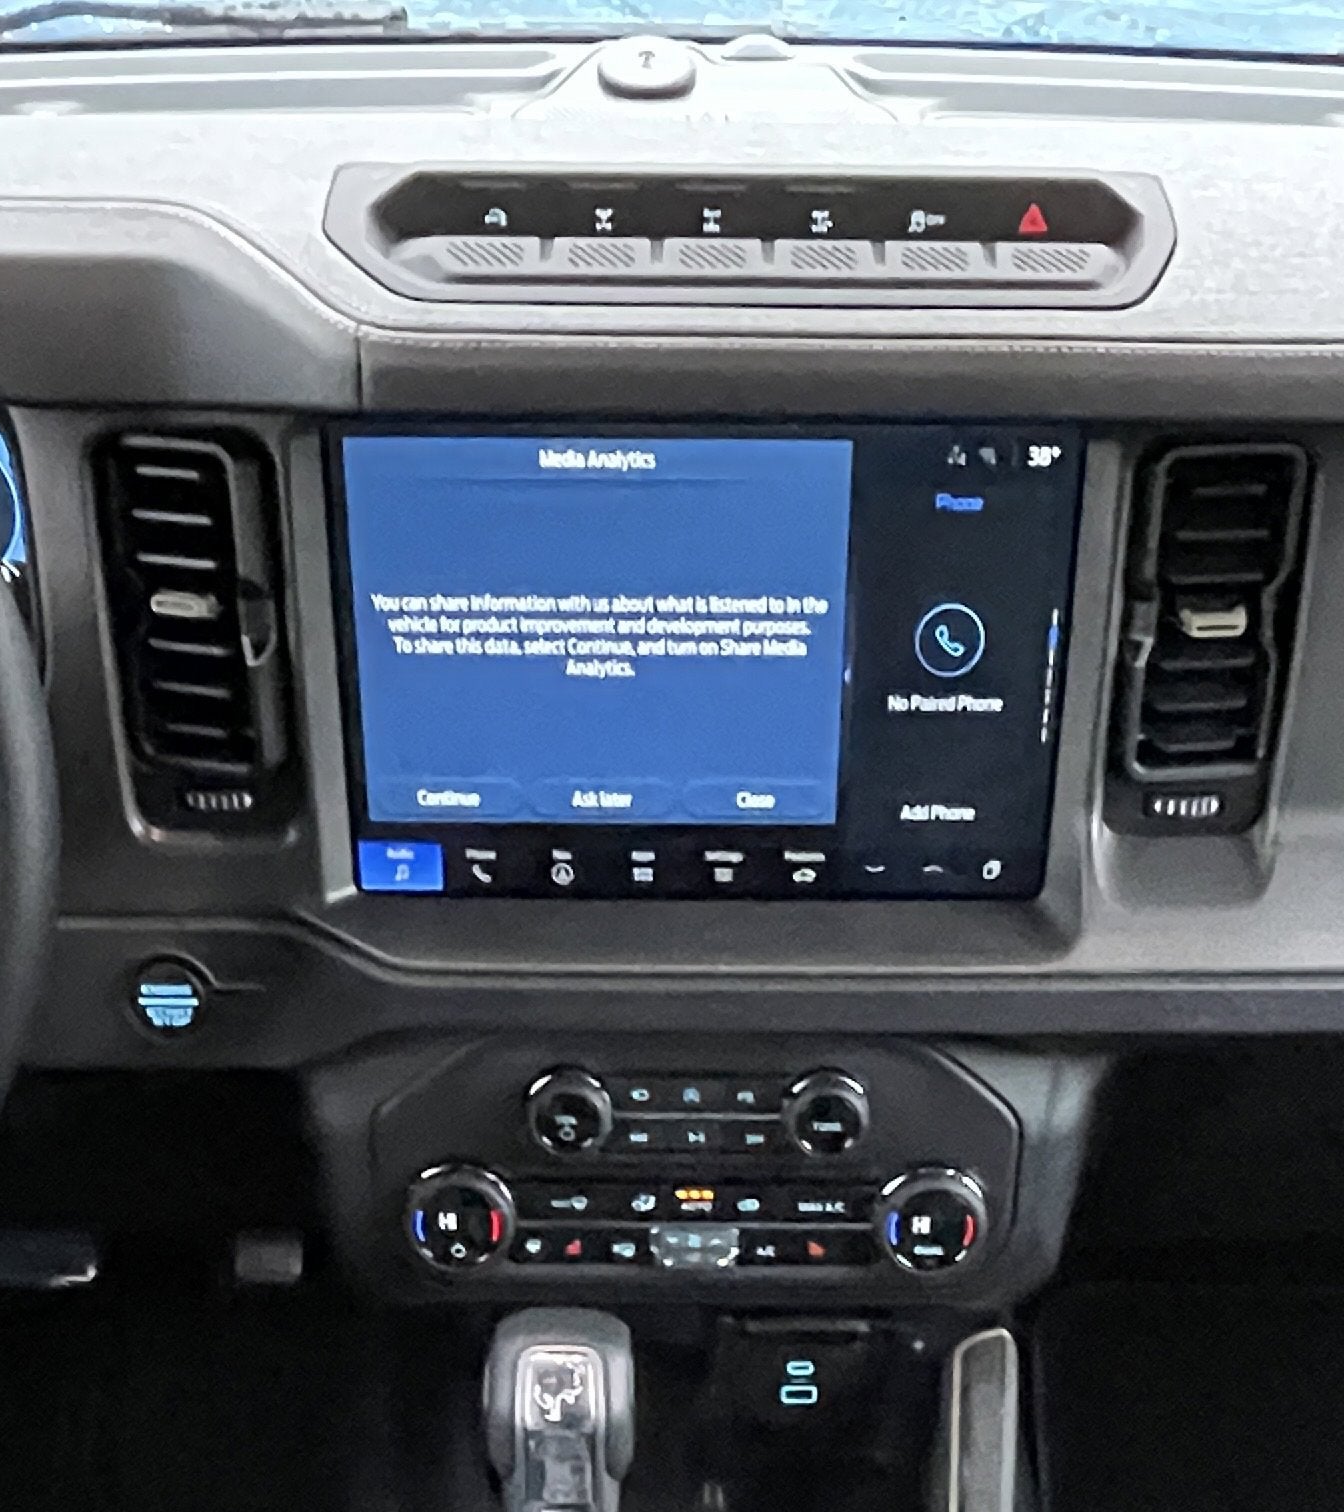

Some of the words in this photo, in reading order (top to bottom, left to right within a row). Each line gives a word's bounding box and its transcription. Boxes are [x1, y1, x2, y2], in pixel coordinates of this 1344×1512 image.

[538, 448, 586, 468] Media
[587, 449, 657, 472] Analytics
[370, 593, 401, 612] You
[402, 596, 428, 612] can
[429, 593, 470, 612] share
[470, 593, 557, 612] information
[557, 594, 592, 612] with
[593, 597, 609, 612] us
[611, 595, 654, 613] about
[656, 595, 694, 613] what
[695, 596, 708, 613] is
[709, 595, 768, 613] listened
[768, 596, 785, 613] to
[786, 596, 802, 613] in
[802, 596, 829, 614] the
[387, 615, 439, 633] vehicle
[439, 615, 461, 633] for
[462, 617, 519, 635] product
[520, 616, 616, 636] improvement
[617, 617, 647, 634] and
[647, 617, 742, 637] development
[742, 619, 812, 638] purposes.
[393, 636, 413, 653] To
[414, 637, 455, 654] share
[455, 637, 484, 654] this
[484, 638, 522, 656] data,
[524, 638, 566, 655] select
[567, 638, 637, 657] Continue,
[637, 638, 666, 656] and
[666, 640, 698, 656] turn
[699, 641, 720, 656] on
[720, 638, 762, 657] Share
[762, 638, 808, 657] Media
[887, 694, 910, 712] No
[910, 694, 957, 712] Paired
[957, 694, 1004, 712] Phone
[416, 789, 482, 808] Continue
[571, 790, 599, 808] Ask
[599, 791, 633, 808] later
[736, 791, 776, 809] Close
[899, 803, 930, 821] Add
[930, 804, 977, 821] Phone
